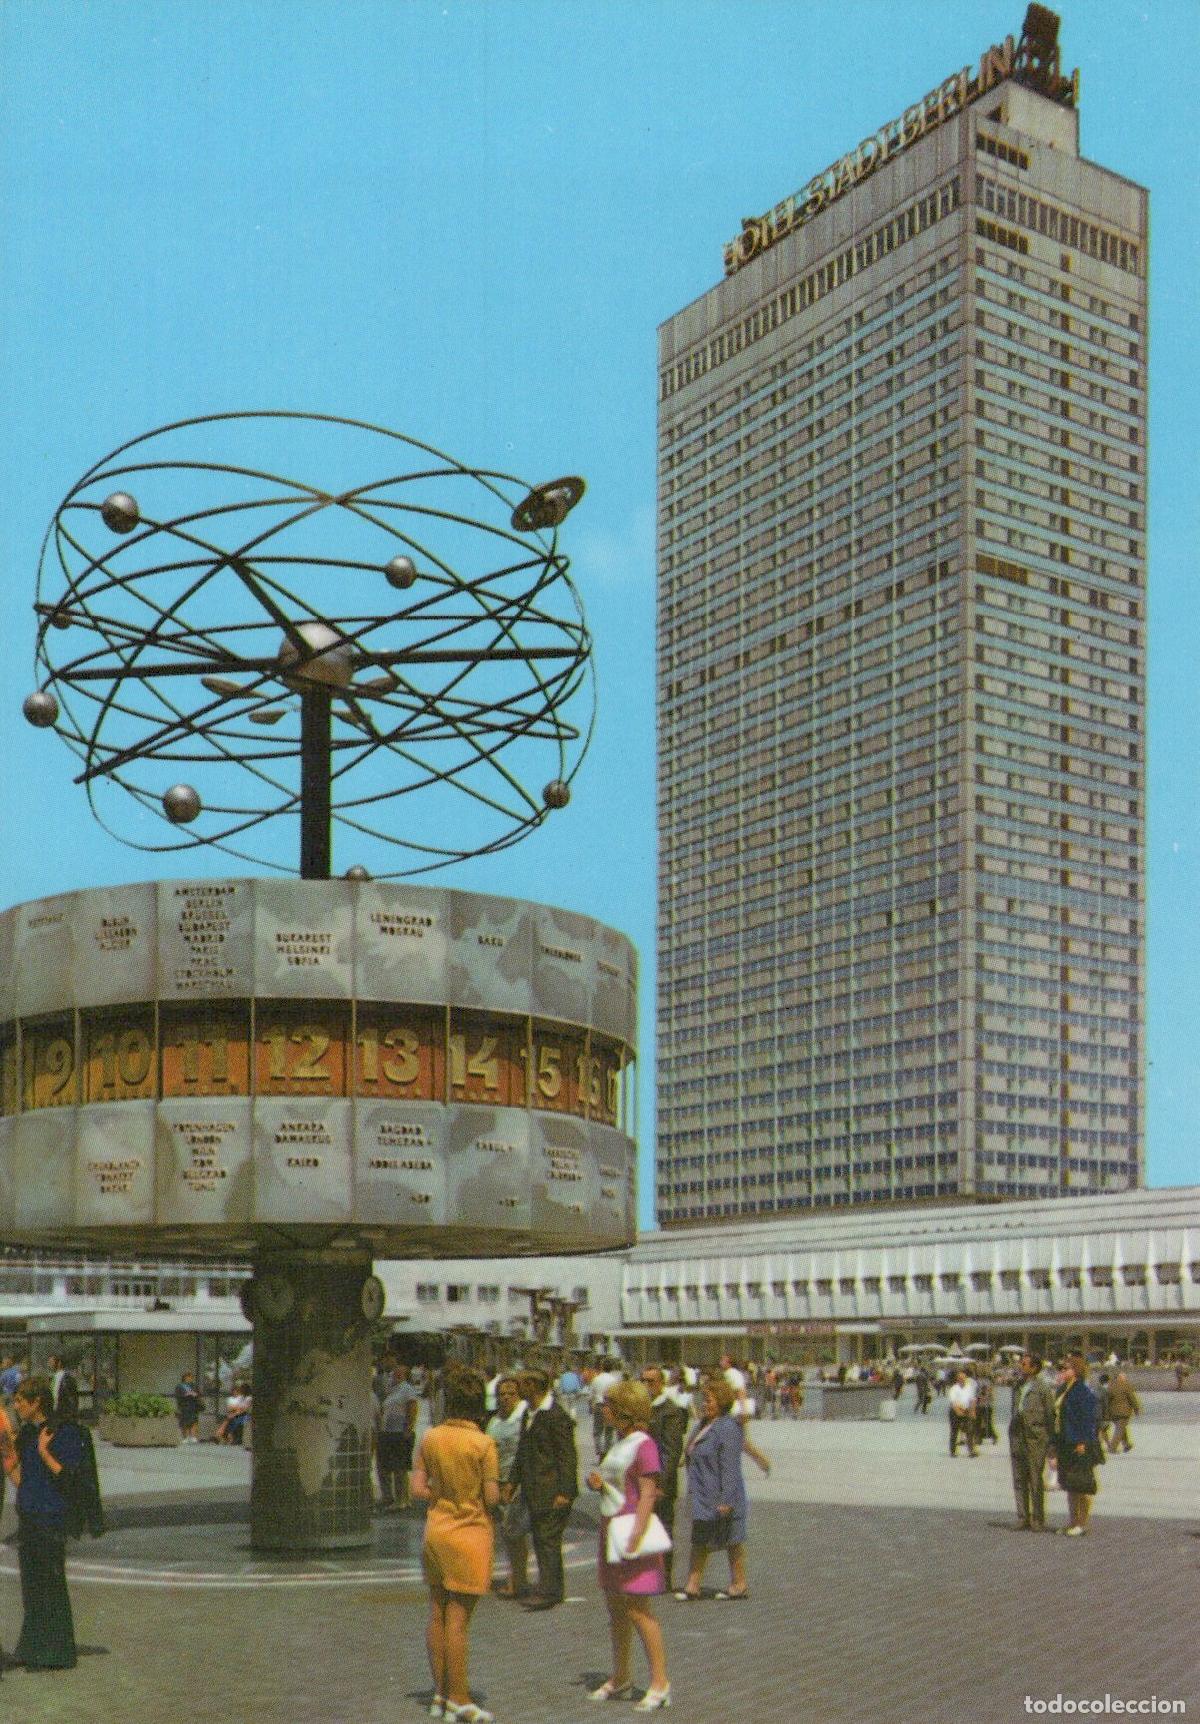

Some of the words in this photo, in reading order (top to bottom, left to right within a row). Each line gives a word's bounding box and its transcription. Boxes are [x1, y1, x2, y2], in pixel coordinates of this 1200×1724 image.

[806, 122, 898, 215] STADT
[900, 34, 1014, 141] BERLIN
[276, 933, 331, 943] BUKAREST
[369, 912, 432, 927] LENINGRAD
[276, 945, 330, 955] HELSINKI
[97, 1031, 150, 1087] 10
[174, 1024, 227, 1083] 11
[263, 1025, 331, 1080] 12
[357, 1029, 420, 1086] 13
[450, 1034, 499, 1090] 14
